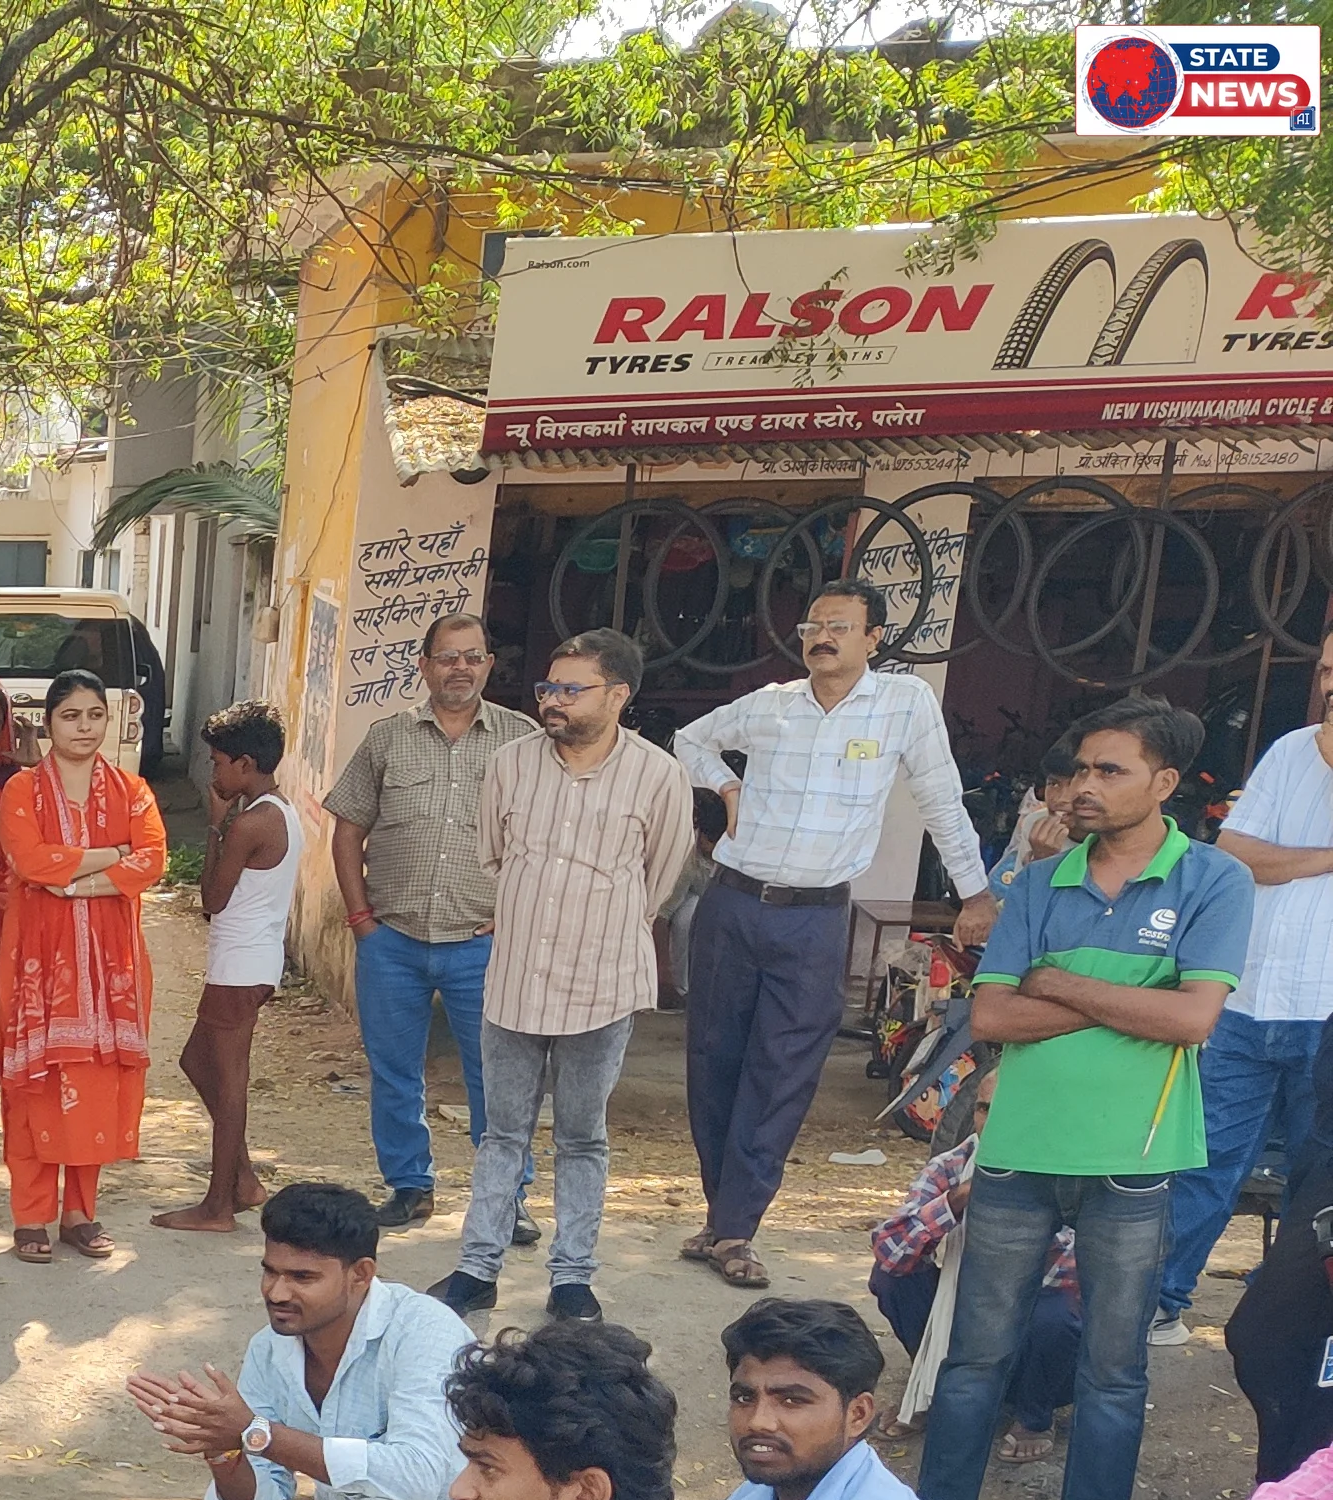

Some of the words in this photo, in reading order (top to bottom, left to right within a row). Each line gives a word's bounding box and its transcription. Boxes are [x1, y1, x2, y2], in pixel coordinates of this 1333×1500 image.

[527, 258, 590, 270] Ralson.com
[593, 284, 996, 345] RALSON
[1222, 331, 1333, 353] TYRES
[585, 352, 693, 376] TYRES
[506, 423, 531, 447] न्यू
[535, 411, 628, 442] विश्वकर्मा
[631, 415, 708, 438] सायकल
[714, 414, 756, 438] एण्ड
[761, 412, 808, 433] टायर
[813, 404, 864, 431] स्टोर,
[871, 402, 925, 428] पलेरा
[1101, 403, 1140, 421] NEW
[1143, 400, 1262, 421] VISHWAKARMA
[1266, 398, 1316, 417] CYCLE
[1319, 398, 1333, 414] &
[418, 521, 466, 559] यहाँ
[365, 560, 411, 599] सभी
[349, 639, 381, 676] एवं
[346, 670, 399, 707] जाती
